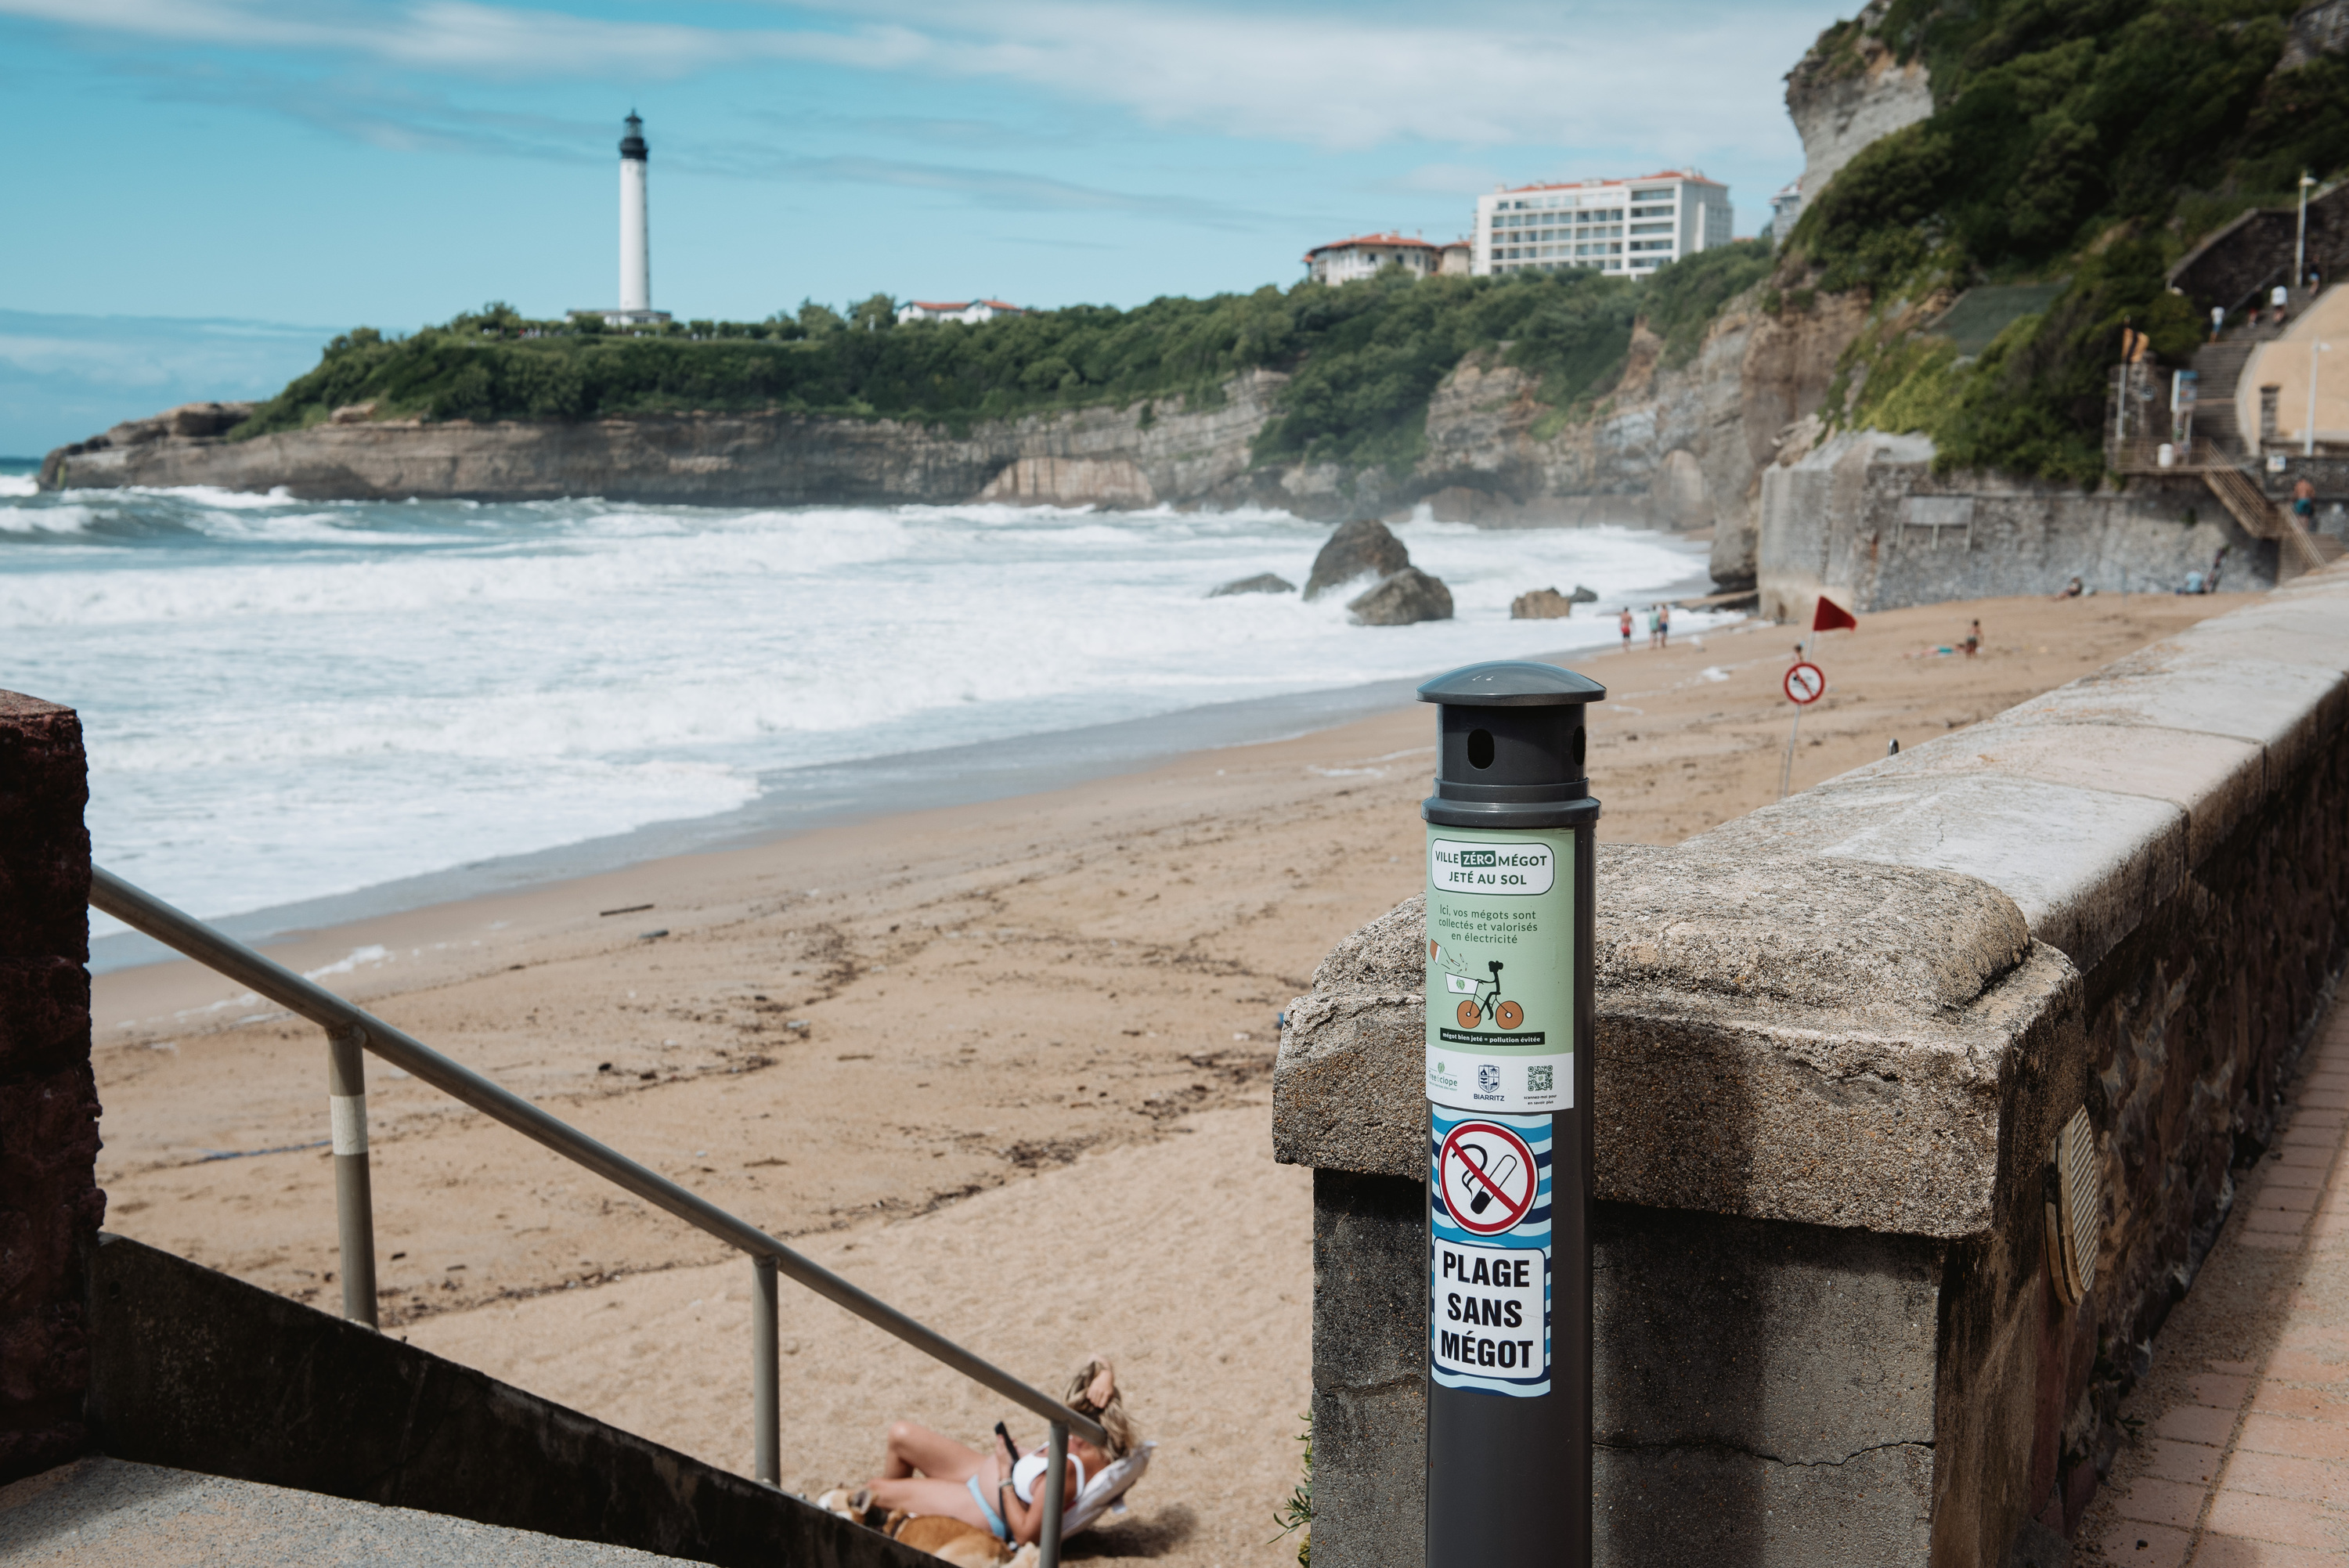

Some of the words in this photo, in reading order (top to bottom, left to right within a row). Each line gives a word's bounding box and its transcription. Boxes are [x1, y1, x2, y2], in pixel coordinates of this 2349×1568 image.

[1435, 850, 1459, 864] VILLE
[1463, 852, 1495, 865] ZÉRO
[1499, 854, 1547, 867] MÉGOT
[1449, 871, 1474, 883] JETÉ
[1478, 874, 1496, 885] AU
[1501, 874, 1527, 885] SOL
[1440, 904, 1451, 916] Ici,
[1471, 910, 1509, 921] mégots
[1438, 918, 1474, 930] collectés
[1491, 922, 1538, 932] valorisés
[1464, 933, 1517, 943] électricité
[1442, 1032, 1457, 1040] mégot
[1443, 1250, 1530, 1288] PLAGE
[1447, 1292, 1522, 1328] SANS
[1441, 1328, 1533, 1368] MÉGOT
